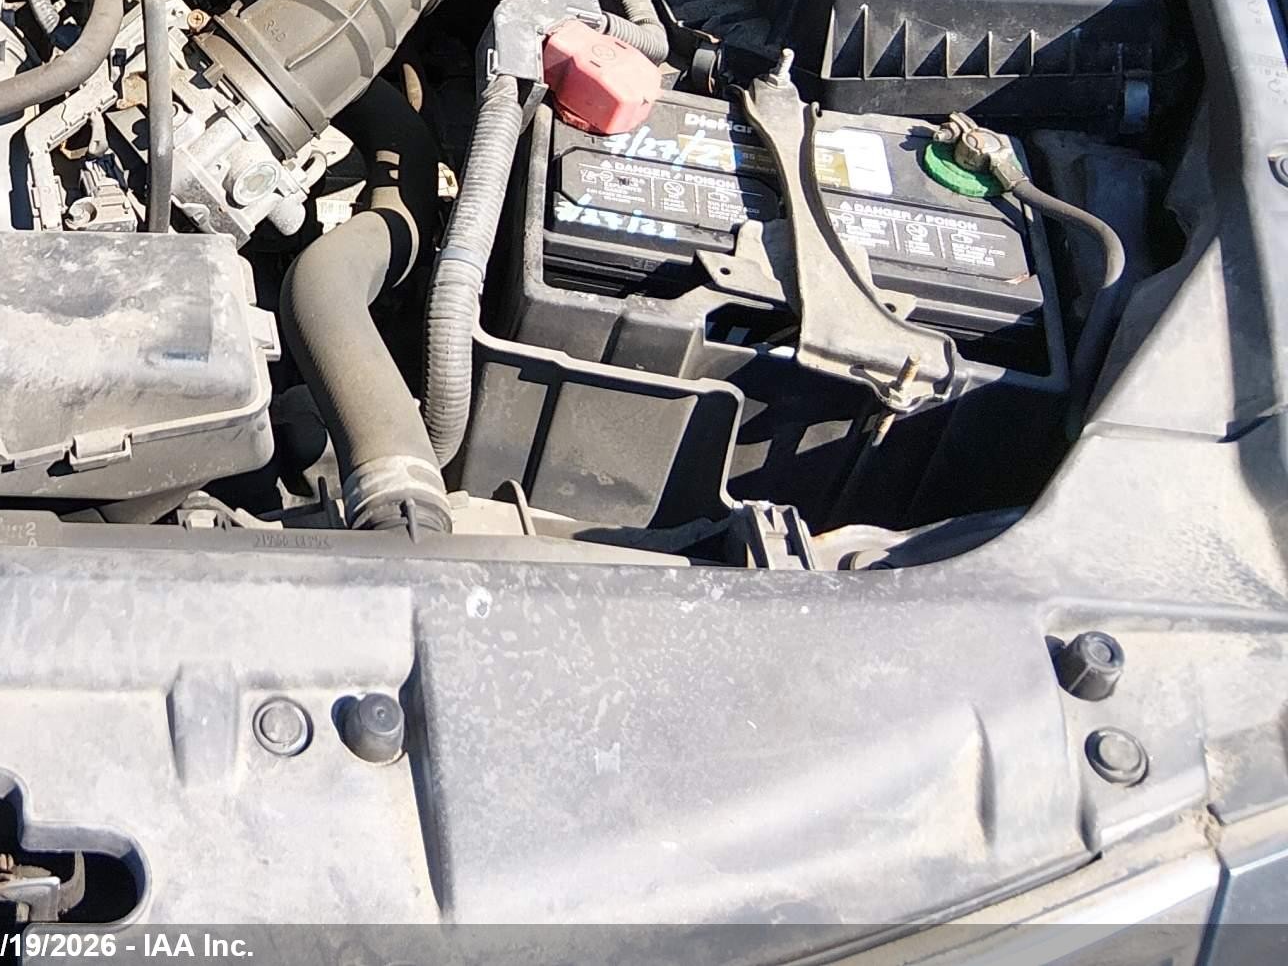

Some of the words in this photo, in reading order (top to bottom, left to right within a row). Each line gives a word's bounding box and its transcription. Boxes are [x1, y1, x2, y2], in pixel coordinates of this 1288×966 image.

[684, 112, 753, 134] DieHar
[614, 162, 671, 179] DANGER
[685, 173, 741, 191] POISON
[853, 203, 912, 221] DANGER
[925, 213, 978, 232] POISON
